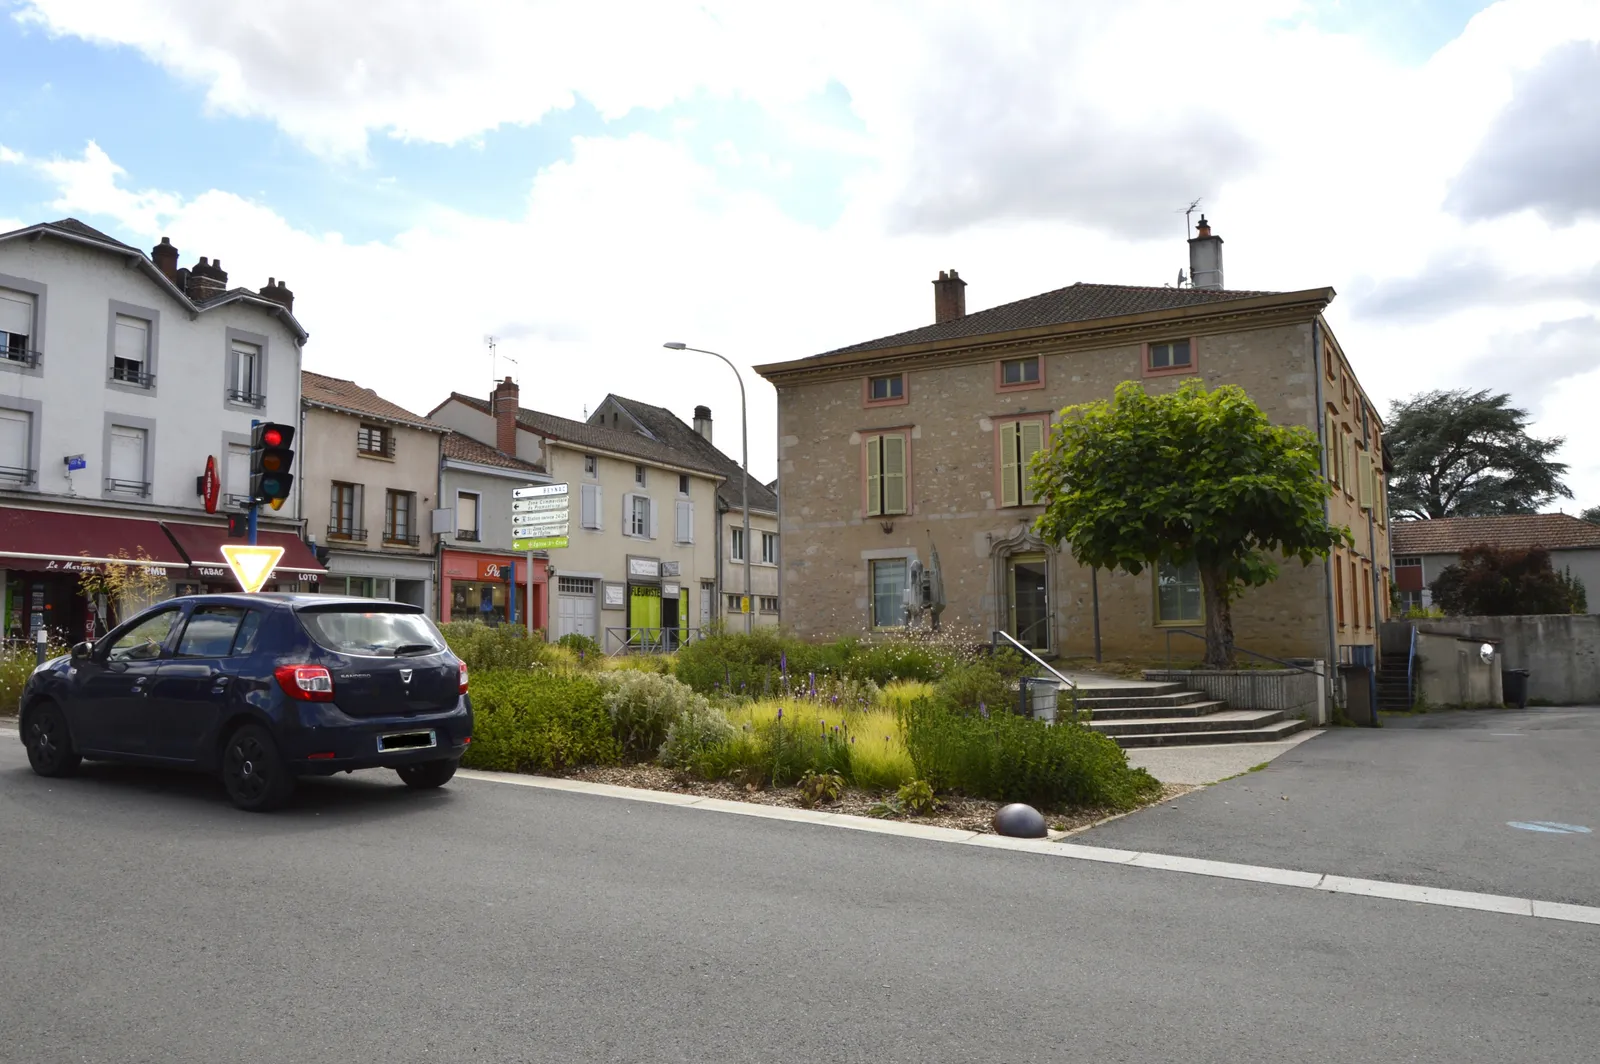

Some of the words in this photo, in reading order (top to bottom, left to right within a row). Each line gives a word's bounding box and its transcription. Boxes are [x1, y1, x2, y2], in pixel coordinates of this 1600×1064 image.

[46, 561, 58, 569] Le
[145, 567, 166, 576] PMU
[199, 567, 224, 576] TABAC
[298, 573, 318, 581] LOTO
[631, 586, 661, 598] FLEURISTE
